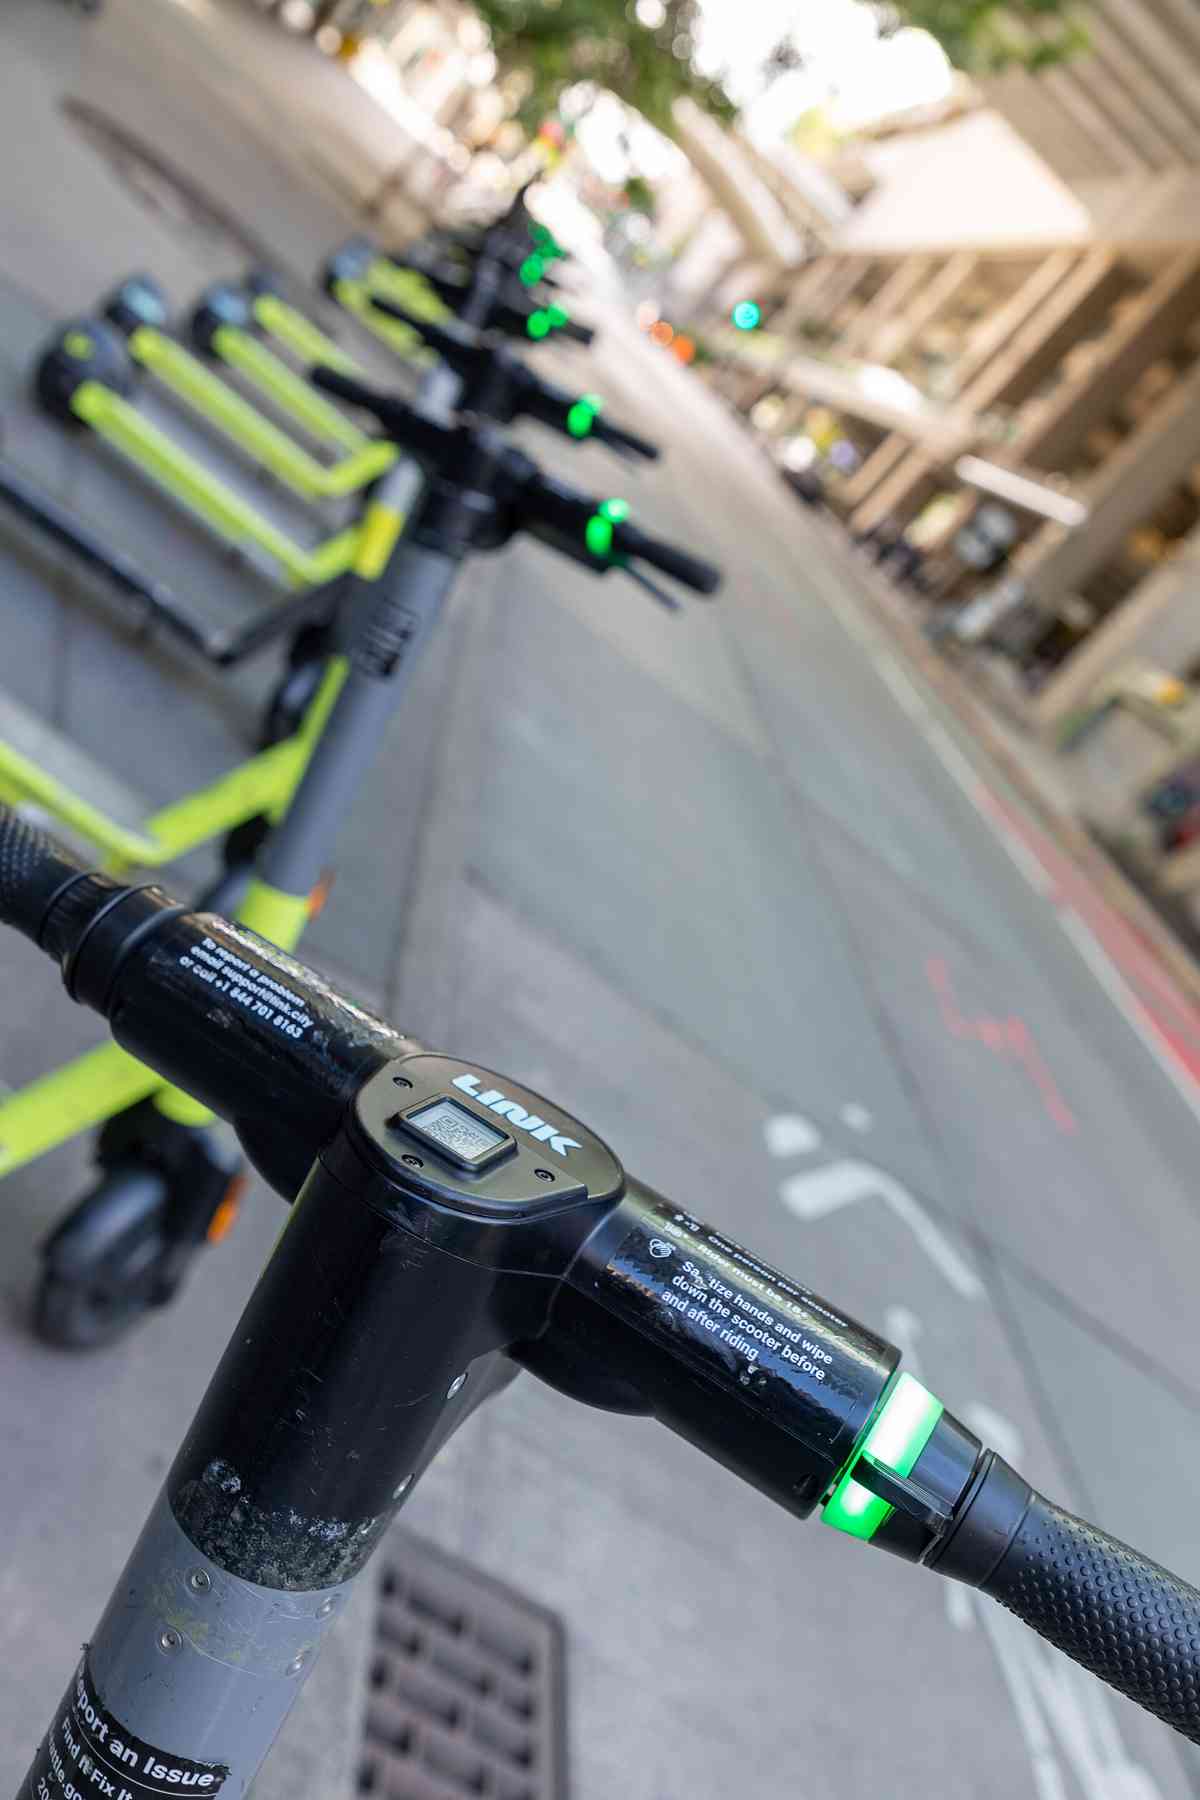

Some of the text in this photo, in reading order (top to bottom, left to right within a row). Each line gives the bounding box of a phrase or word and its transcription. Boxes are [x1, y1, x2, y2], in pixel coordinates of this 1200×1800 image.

[179, 956, 194, 968] or
[192, 964, 217, 983] call
[230, 987, 253, 1006] 844
[251, 1001, 274, 1019] 701
[273, 1015, 303, 1038] 8163
[190, 946, 314, 1028] email support@link.city
[215, 947, 251, 971] report
[249, 968, 260, 978] a
[257, 975, 305, 1007] problem
[452, 1073, 583, 1157] LINK
[661, 1290, 759, 1362] and after riding
[672, 1275, 826, 1381] down the scooter before
[682, 1261, 734, 1299] Satize
[734, 1293, 773, 1326] hands
[774, 1320, 803, 1344] and
[802, 1338, 833, 1365] wipe
[766, 1287, 783, 1302] be
[62, 1716, 80, 1760] Find
[90, 1768, 116, 1797] Fix
[109, 1738, 139, 1767] an
[143, 1756, 215, 1787] Issue
